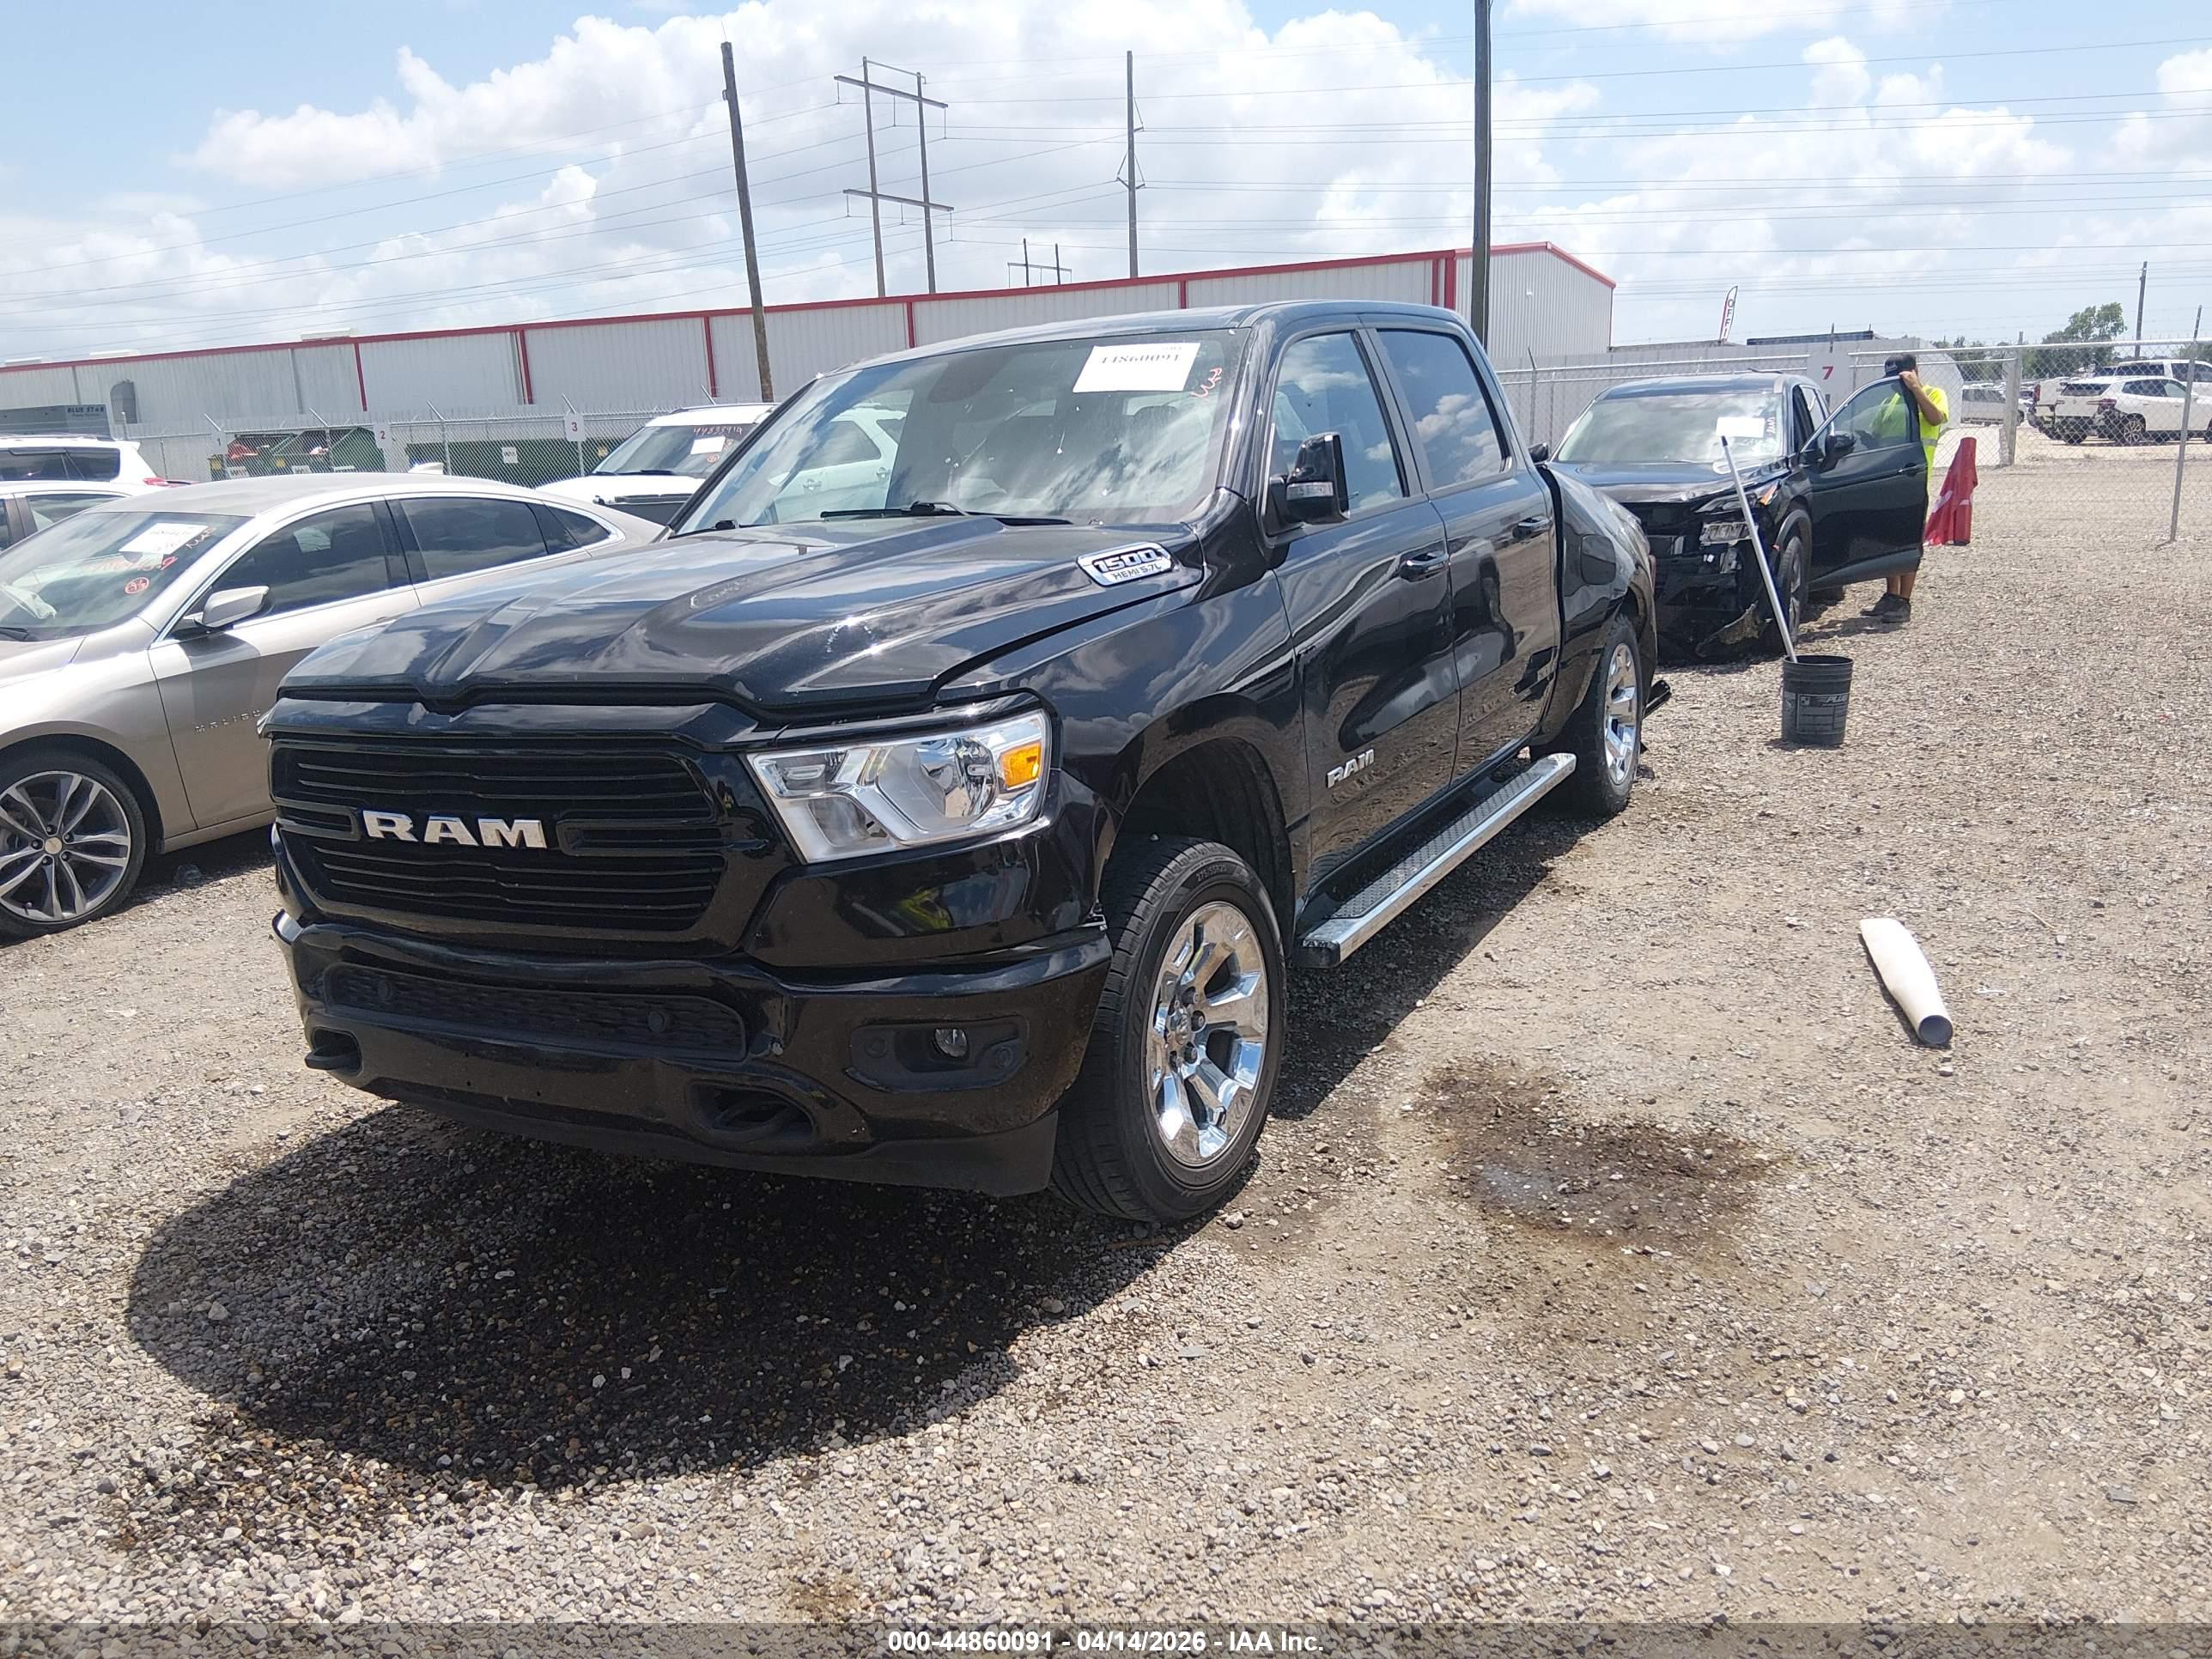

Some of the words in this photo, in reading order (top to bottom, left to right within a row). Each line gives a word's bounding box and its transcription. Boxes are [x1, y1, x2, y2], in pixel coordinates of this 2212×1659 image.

[1822, 366, 1834, 380] 7
[380, 430, 386, 440] 2
[571, 422, 578, 432] 3
[1093, 549, 1156, 572] 1500
[1113, 568, 1139, 580] HEMI
[1142, 563, 1162, 574] 5.7L
[195, 709, 261, 732] MALIBU
[1327, 748, 1375, 789] RAM
[362, 810, 548, 849] RAM
